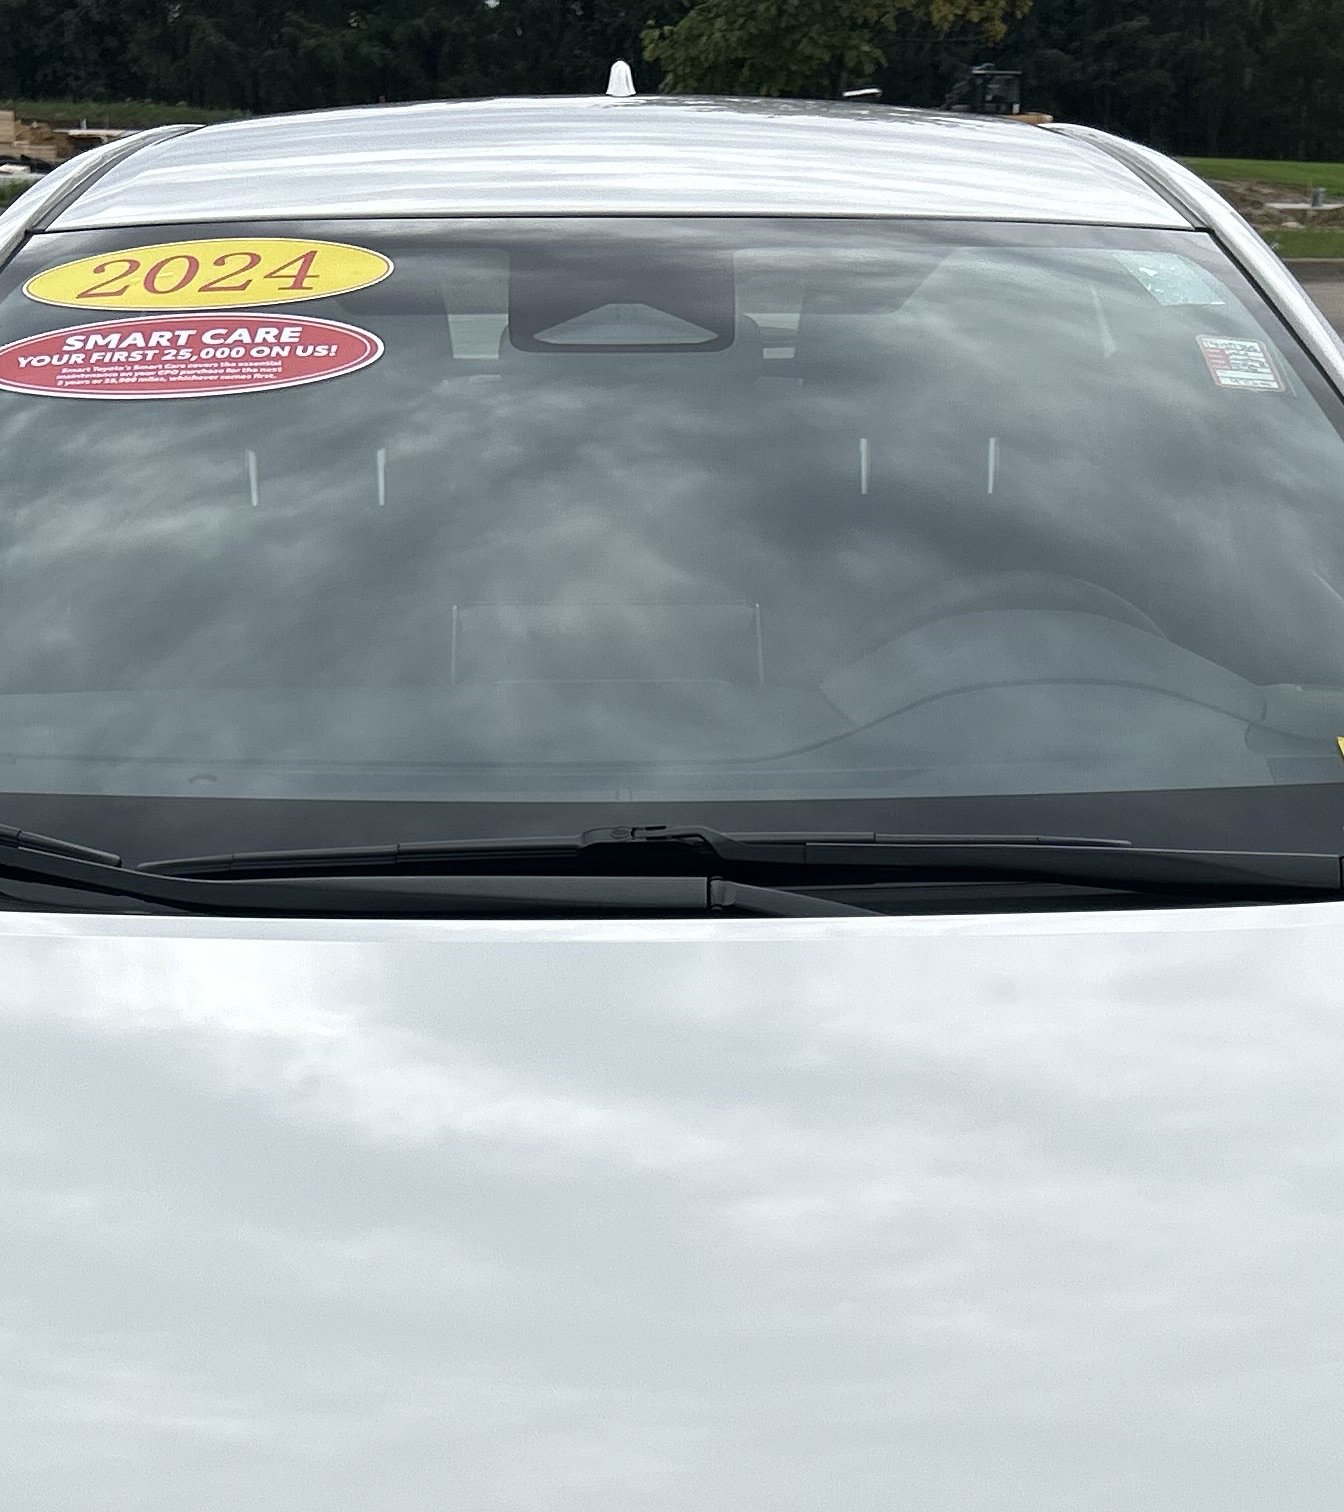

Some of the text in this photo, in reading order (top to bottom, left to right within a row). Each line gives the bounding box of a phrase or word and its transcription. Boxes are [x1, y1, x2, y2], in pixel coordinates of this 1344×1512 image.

[75, 250, 320, 299] 2024
[61, 326, 303, 351] SMART CARE
[17, 344, 338, 368] YOUR FIRST 25,000 ON US!
